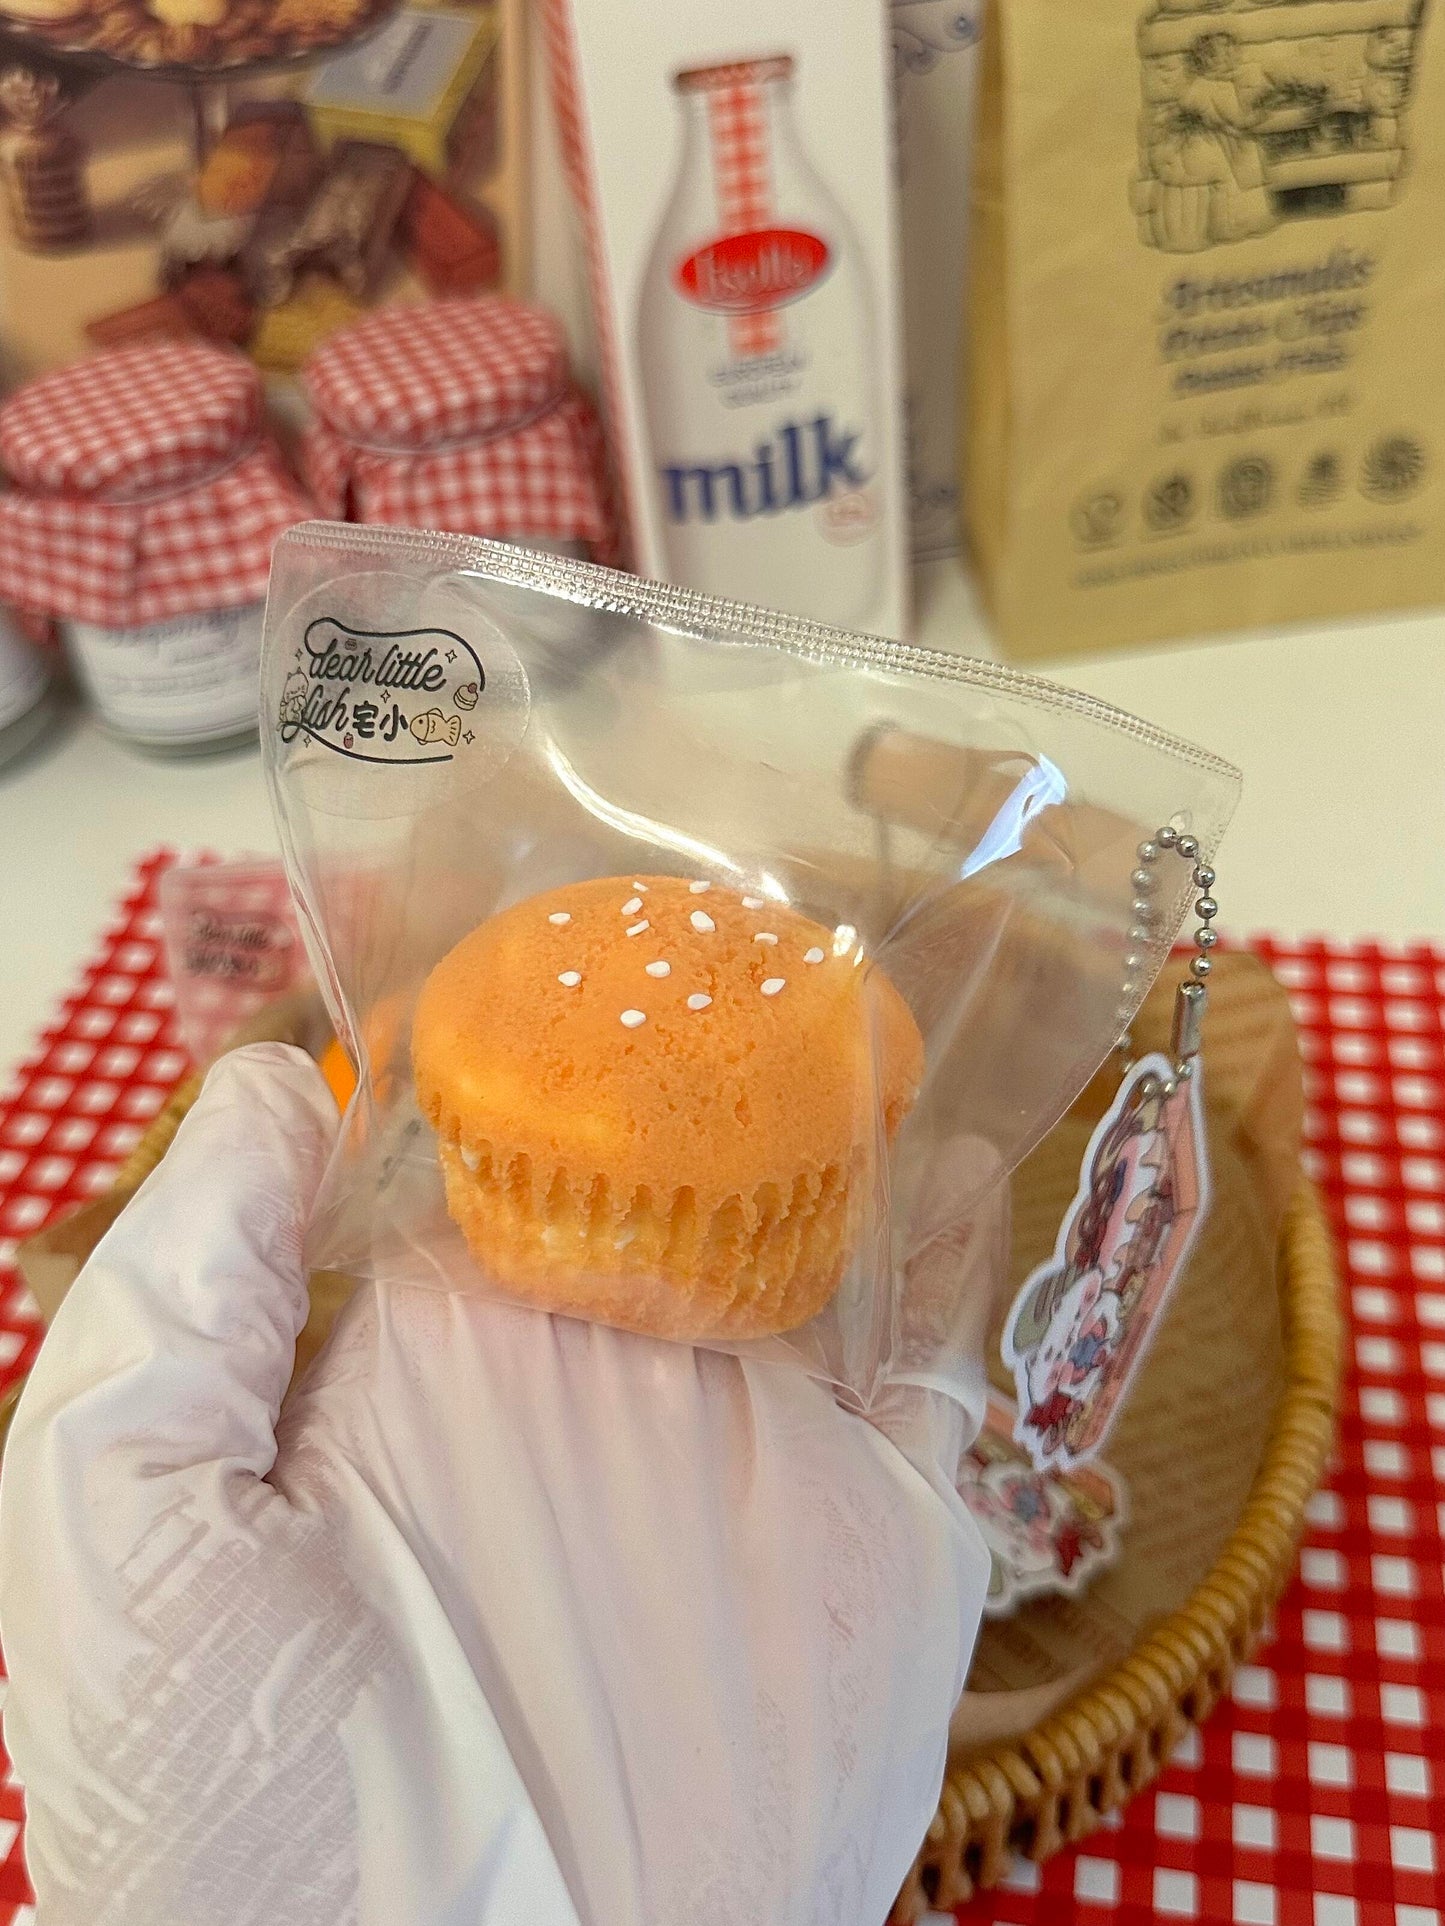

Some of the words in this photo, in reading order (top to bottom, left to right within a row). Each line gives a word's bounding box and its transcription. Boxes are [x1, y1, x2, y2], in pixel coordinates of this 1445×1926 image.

[663, 414, 869, 525] milk
[309, 638, 376, 682] dear
[374, 644, 447, 692] little
[352, 701, 409, 742] 宅小
